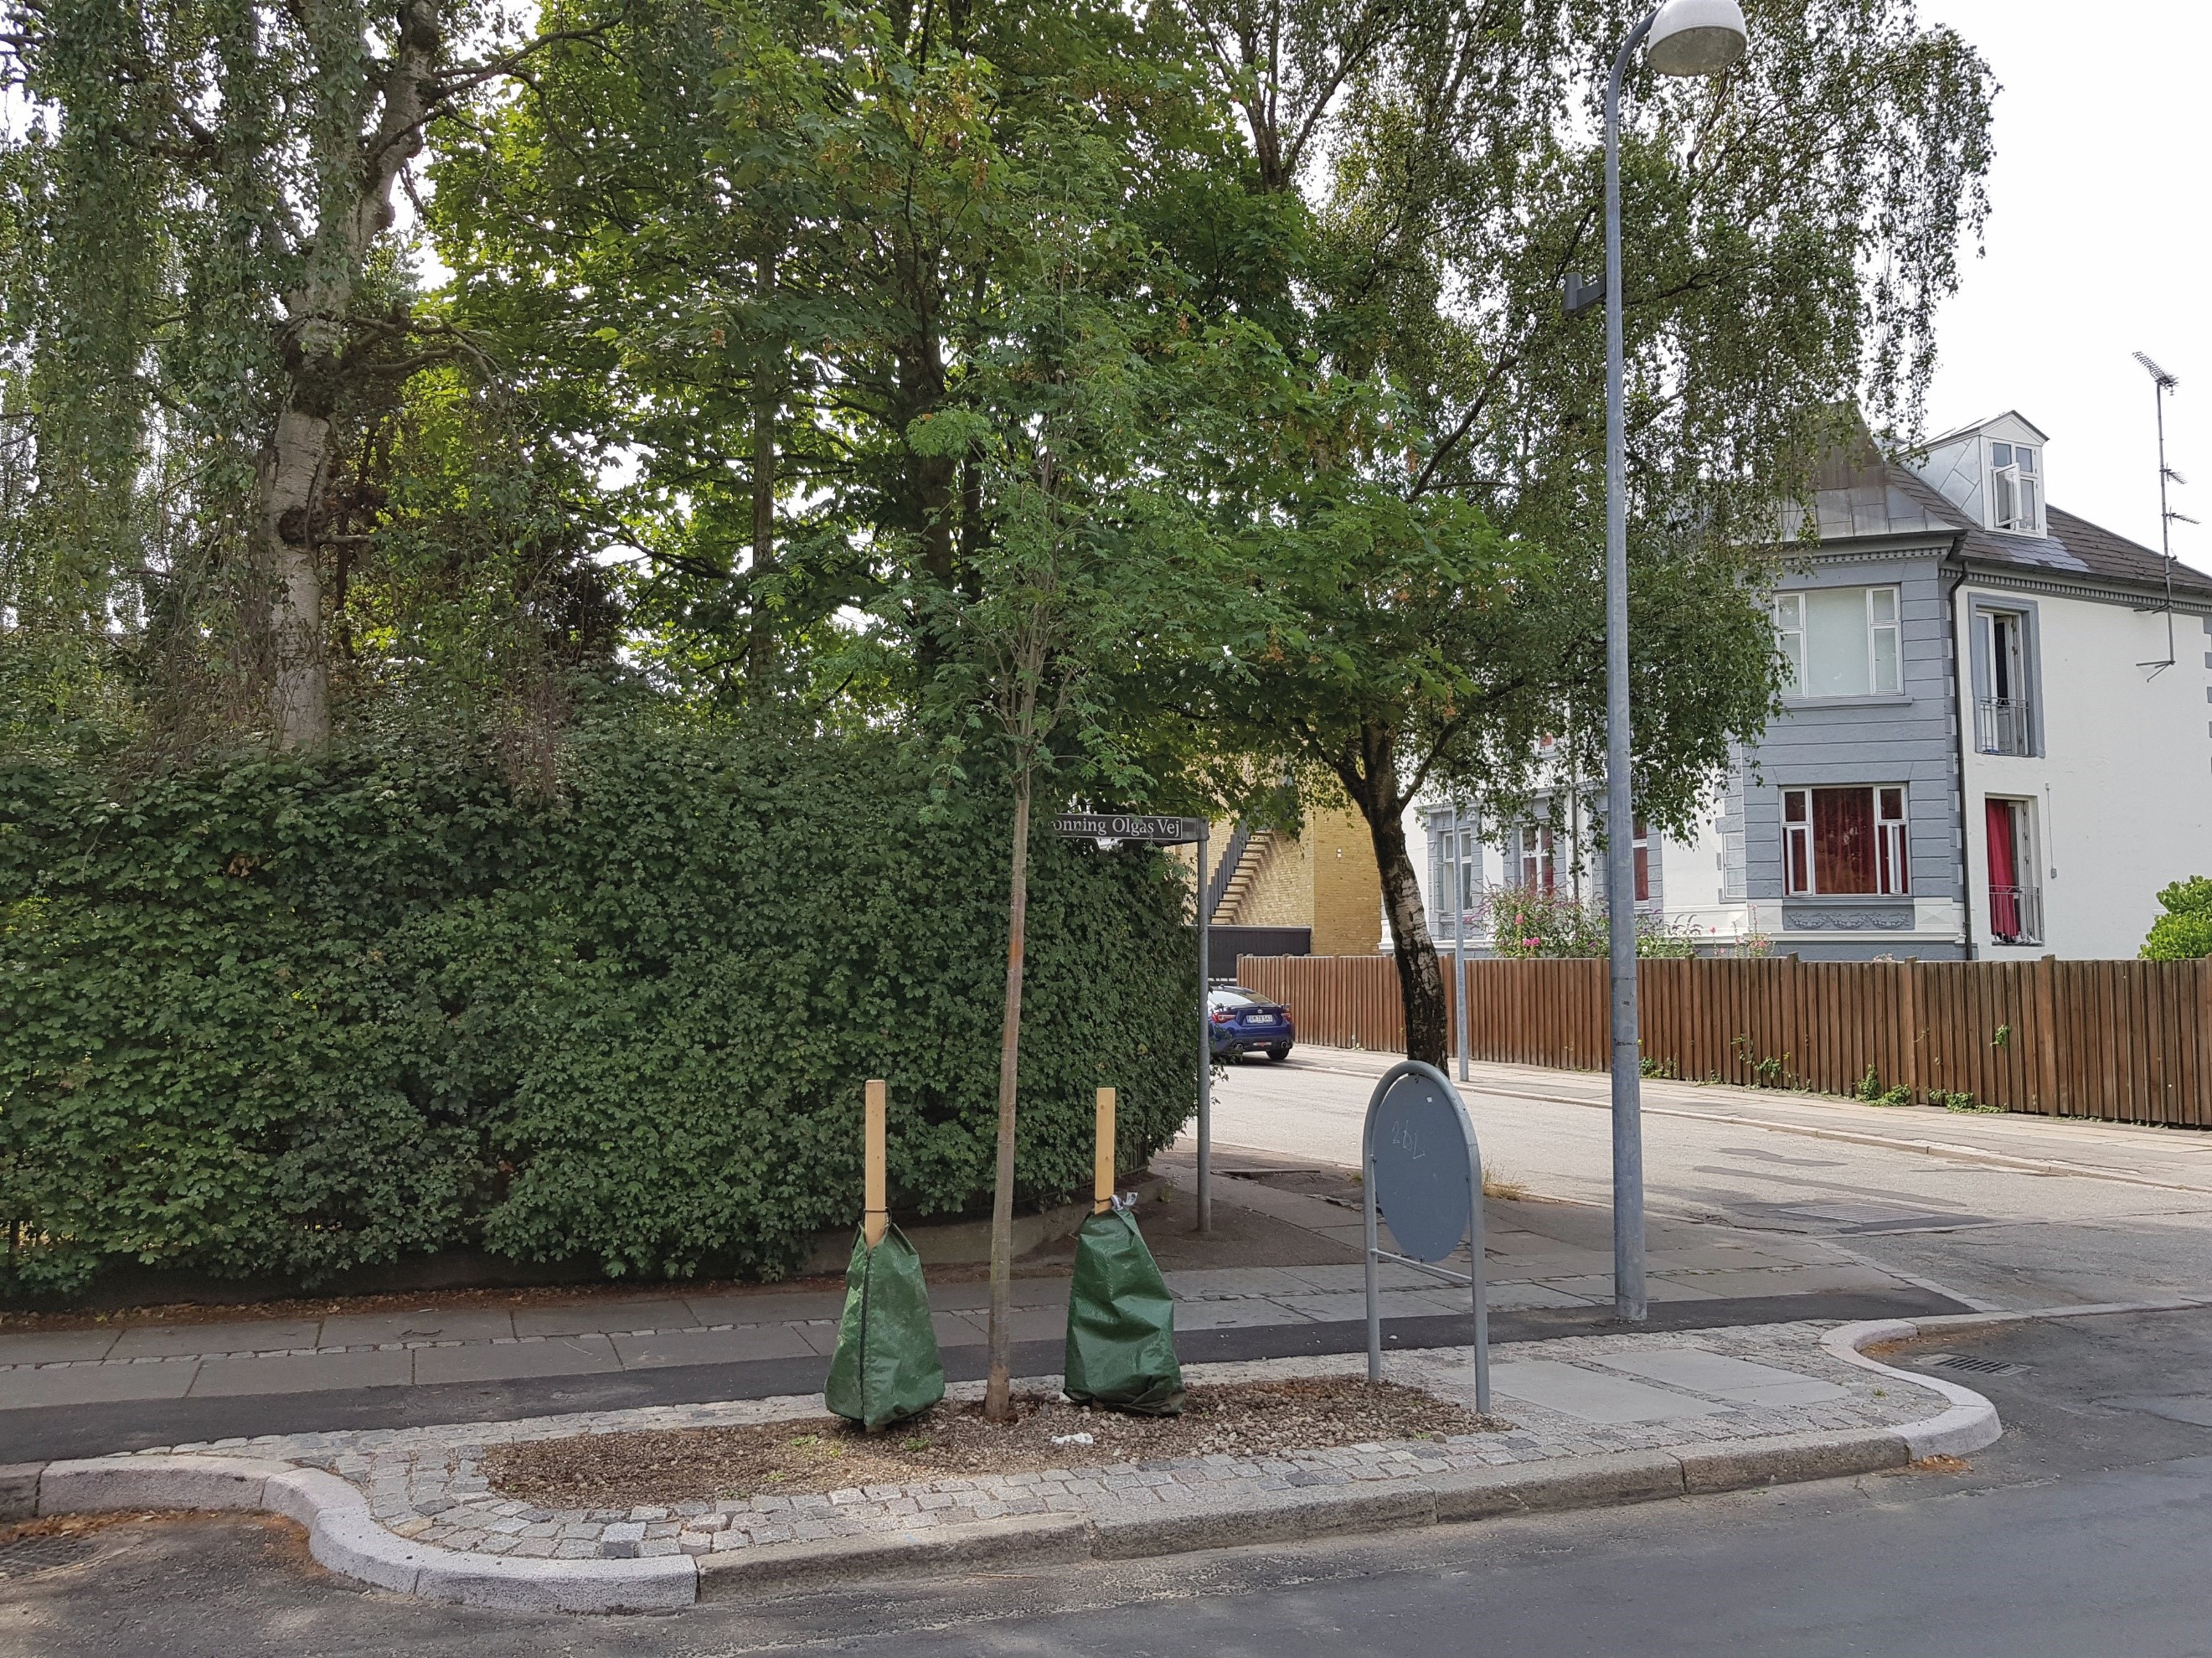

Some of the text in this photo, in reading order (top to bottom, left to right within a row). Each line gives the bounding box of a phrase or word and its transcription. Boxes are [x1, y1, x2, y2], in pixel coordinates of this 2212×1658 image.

[1051, 817, 1179, 836] onning Olgas Vej
